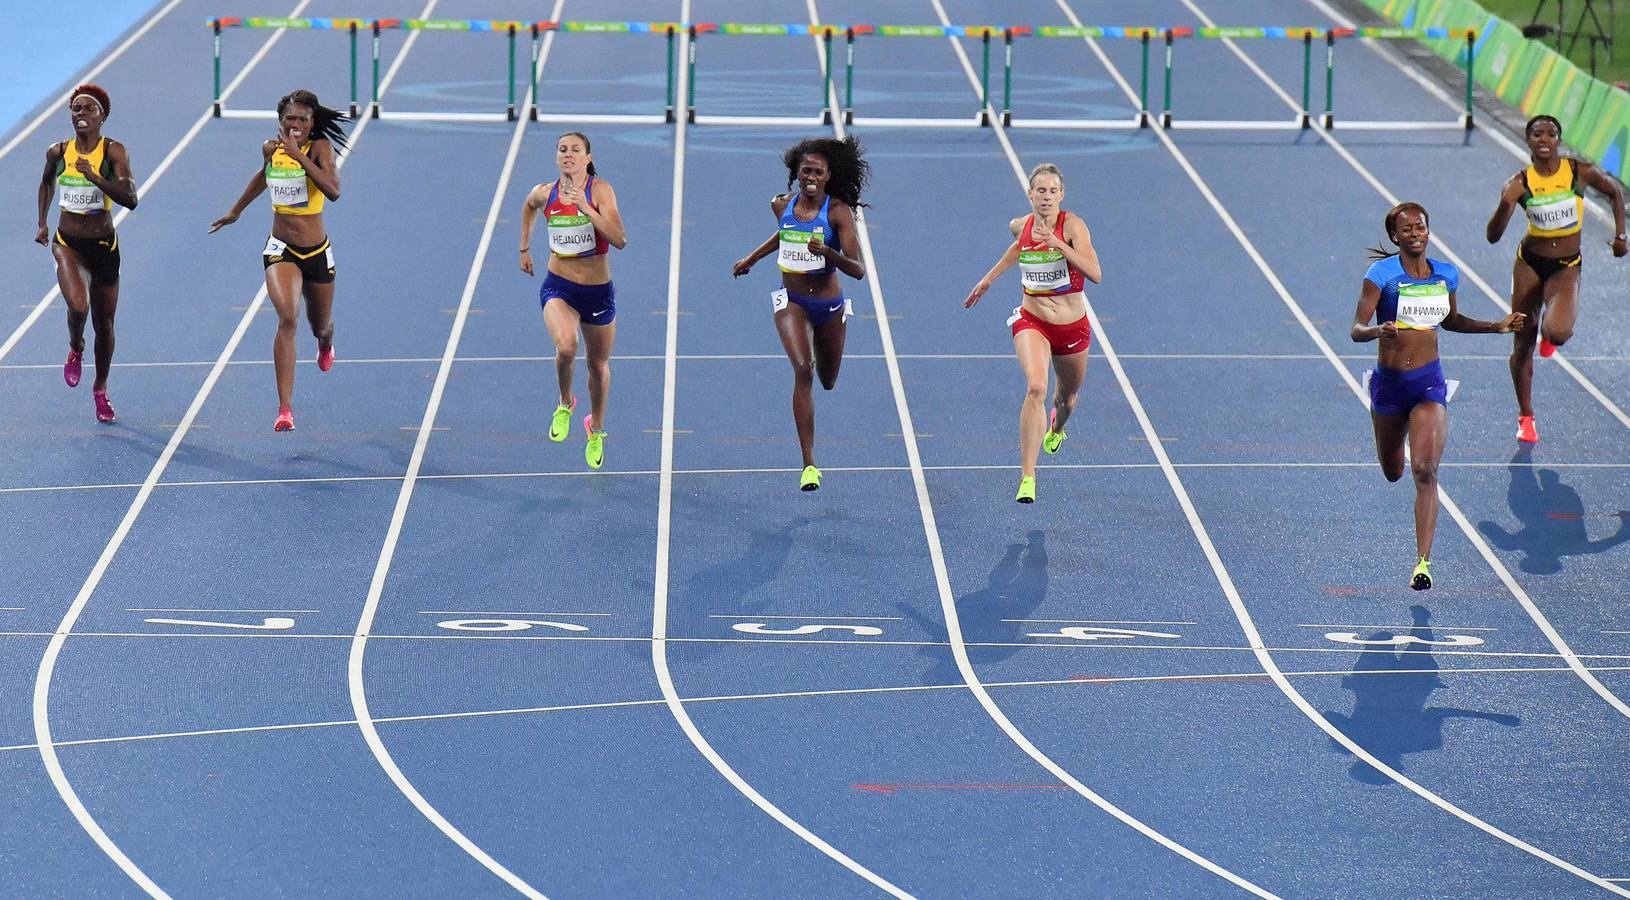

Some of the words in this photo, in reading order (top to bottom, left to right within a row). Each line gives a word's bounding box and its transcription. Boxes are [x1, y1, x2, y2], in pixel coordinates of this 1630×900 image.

[271, 186, 301, 197] RACEY
[1532, 207, 1574, 223] NUGENT
[552, 233, 594, 246] HEJNOVA
[1025, 269, 1067, 282] PETERSEN
[775, 294, 782, 306] 5
[1401, 305, 1448, 317] MUHAMMAD
[143, 616, 295, 630] 7
[436, 619, 590, 632] 6
[732, 622, 883, 636] 5
[1025, 626, 1182, 640] 4
[1324, 631, 1485, 648] 3
